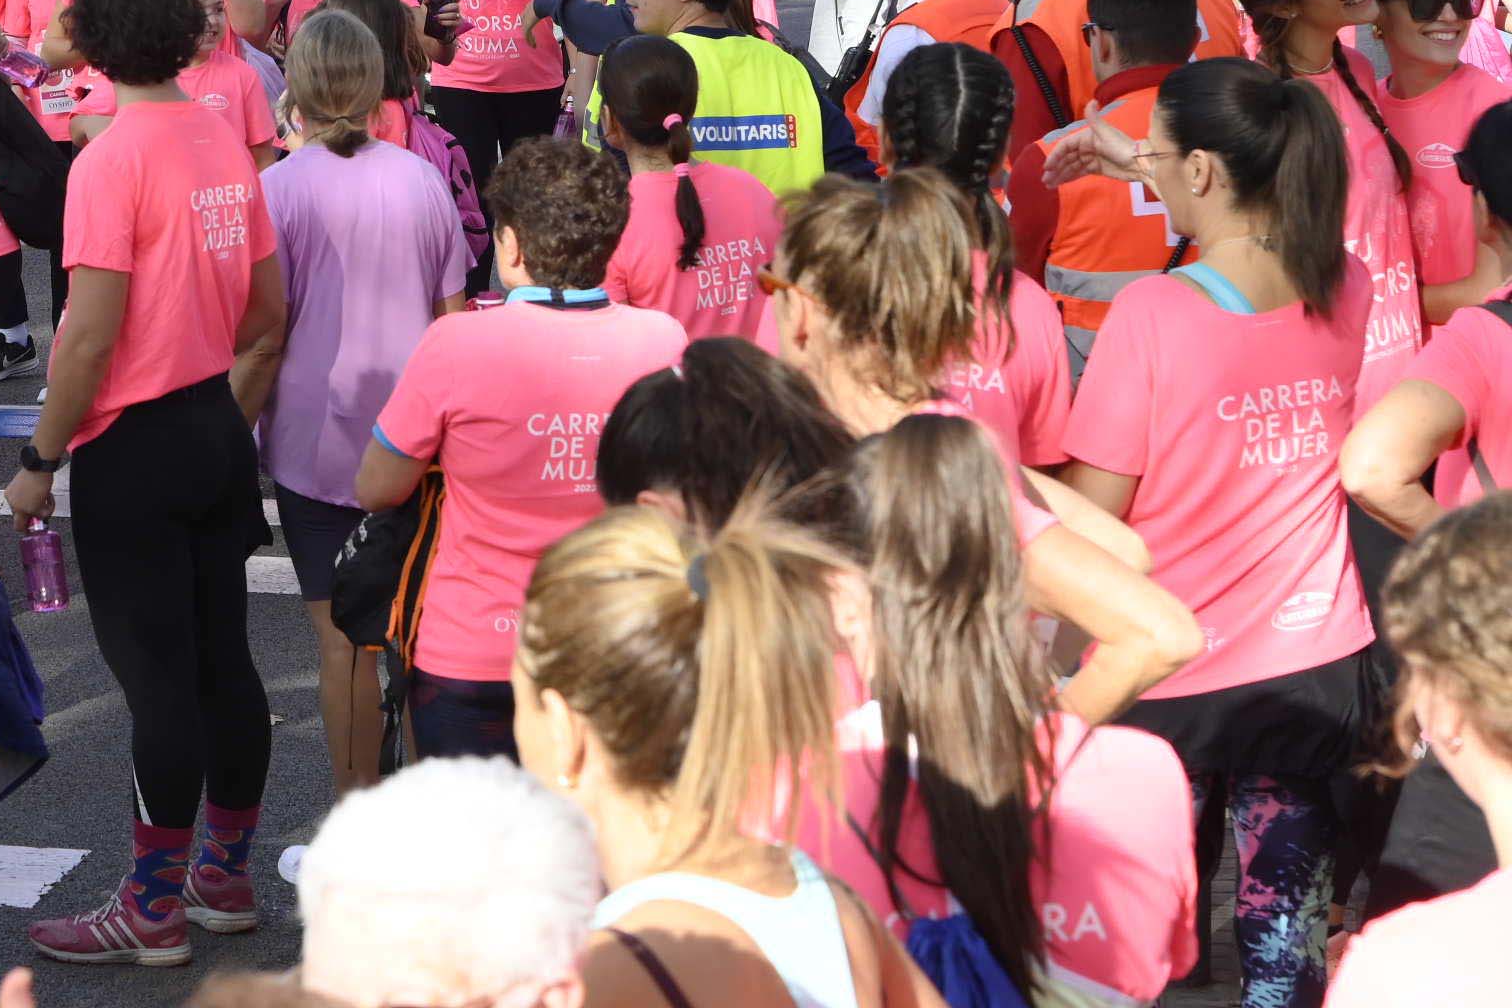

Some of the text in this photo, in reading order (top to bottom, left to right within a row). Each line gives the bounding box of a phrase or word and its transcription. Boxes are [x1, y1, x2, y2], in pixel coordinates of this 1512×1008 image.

[464, 37, 518, 53] SUMA
[190, 184, 256, 212] CARRERA
[202, 205, 244, 230] DE LA
[694, 236, 767, 269] ARRERA
[697, 261, 753, 290] DE LA
[1215, 374, 1344, 422] CARRERA
[1245, 407, 1326, 444] DE LA
[550, 437, 584, 459] DE
[1239, 431, 1329, 470] MUJER
